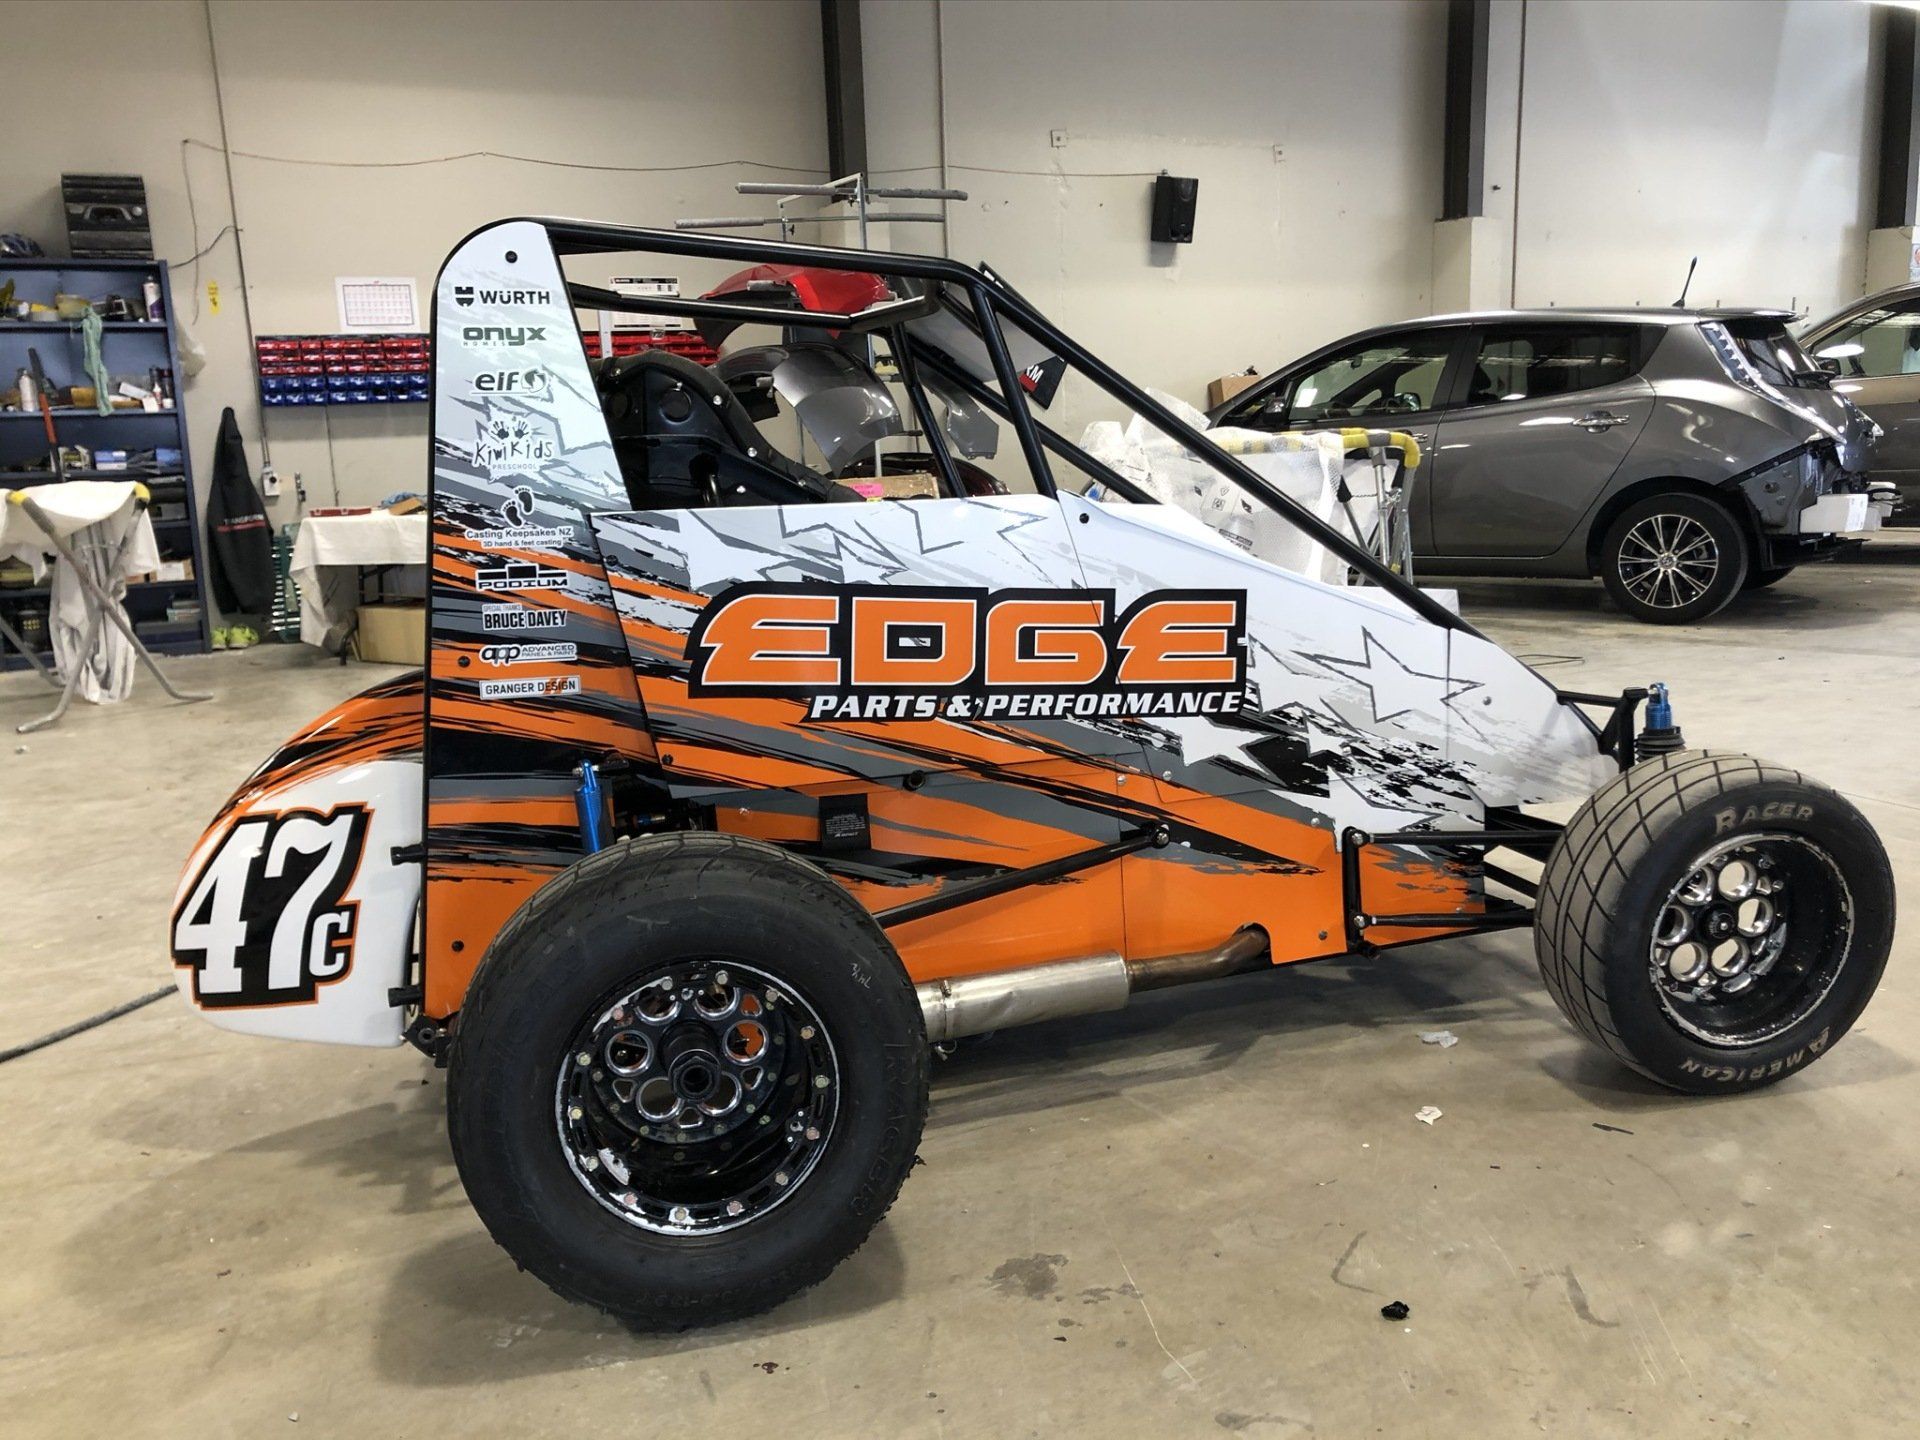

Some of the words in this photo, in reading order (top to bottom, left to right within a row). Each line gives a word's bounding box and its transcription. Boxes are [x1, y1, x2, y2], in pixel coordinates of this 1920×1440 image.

[479, 290, 550, 305] WÜRTH
[463, 327, 547, 346] onyx
[475, 371, 520, 391] elf
[466, 530, 503, 539] Casting
[505, 528, 556, 538] Keepsakes
[559, 527, 572, 536] NZ
[536, 538, 562, 547] casting
[479, 579, 568, 589] PODIUM
[484, 612, 524, 629] BRUCE
[527, 610, 566, 627] DAVEY
[700, 593, 1237, 687] EDGE
[486, 683, 535, 695] GRANGER
[537, 680, 576, 692] DESIGN
[811, 695, 937, 718] PARTS
[947, 695, 971, 717] &
[984, 691, 1243, 716] PERFORMANCE
[1715, 802, 1813, 836] RACER
[1680, 1026, 1830, 1082] AMERICAN
